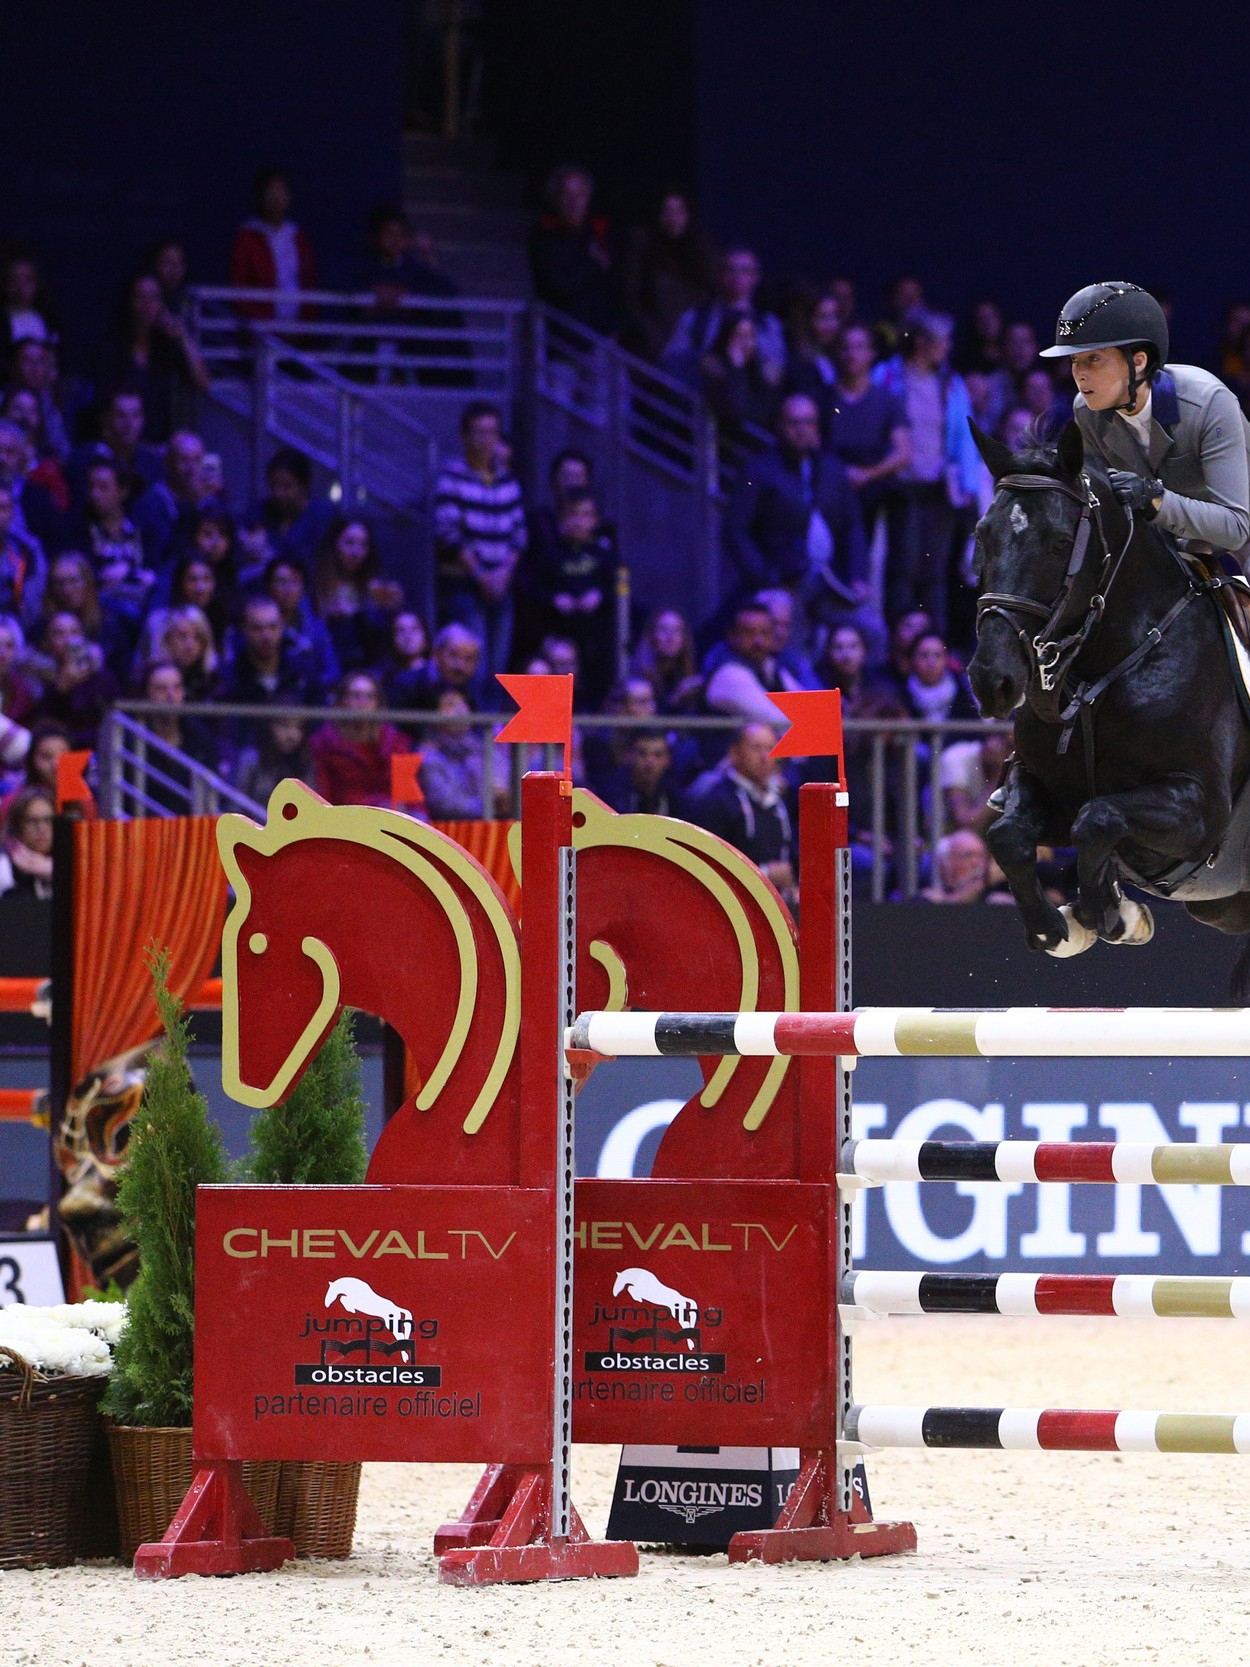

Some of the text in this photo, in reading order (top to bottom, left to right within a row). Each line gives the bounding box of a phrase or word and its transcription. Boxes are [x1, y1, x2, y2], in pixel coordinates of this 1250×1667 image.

[300, 1313, 439, 1339] jumping
[589, 1303, 723, 1329] jumping
[311, 1365, 424, 1384] obstacles
[600, 1353, 710, 1371] obstacles
[572, 1376, 766, 1403] rtenaire officiel
[254, 1391, 482, 1420] partenaire officiel
[623, 1479, 763, 1507] LONGINES
